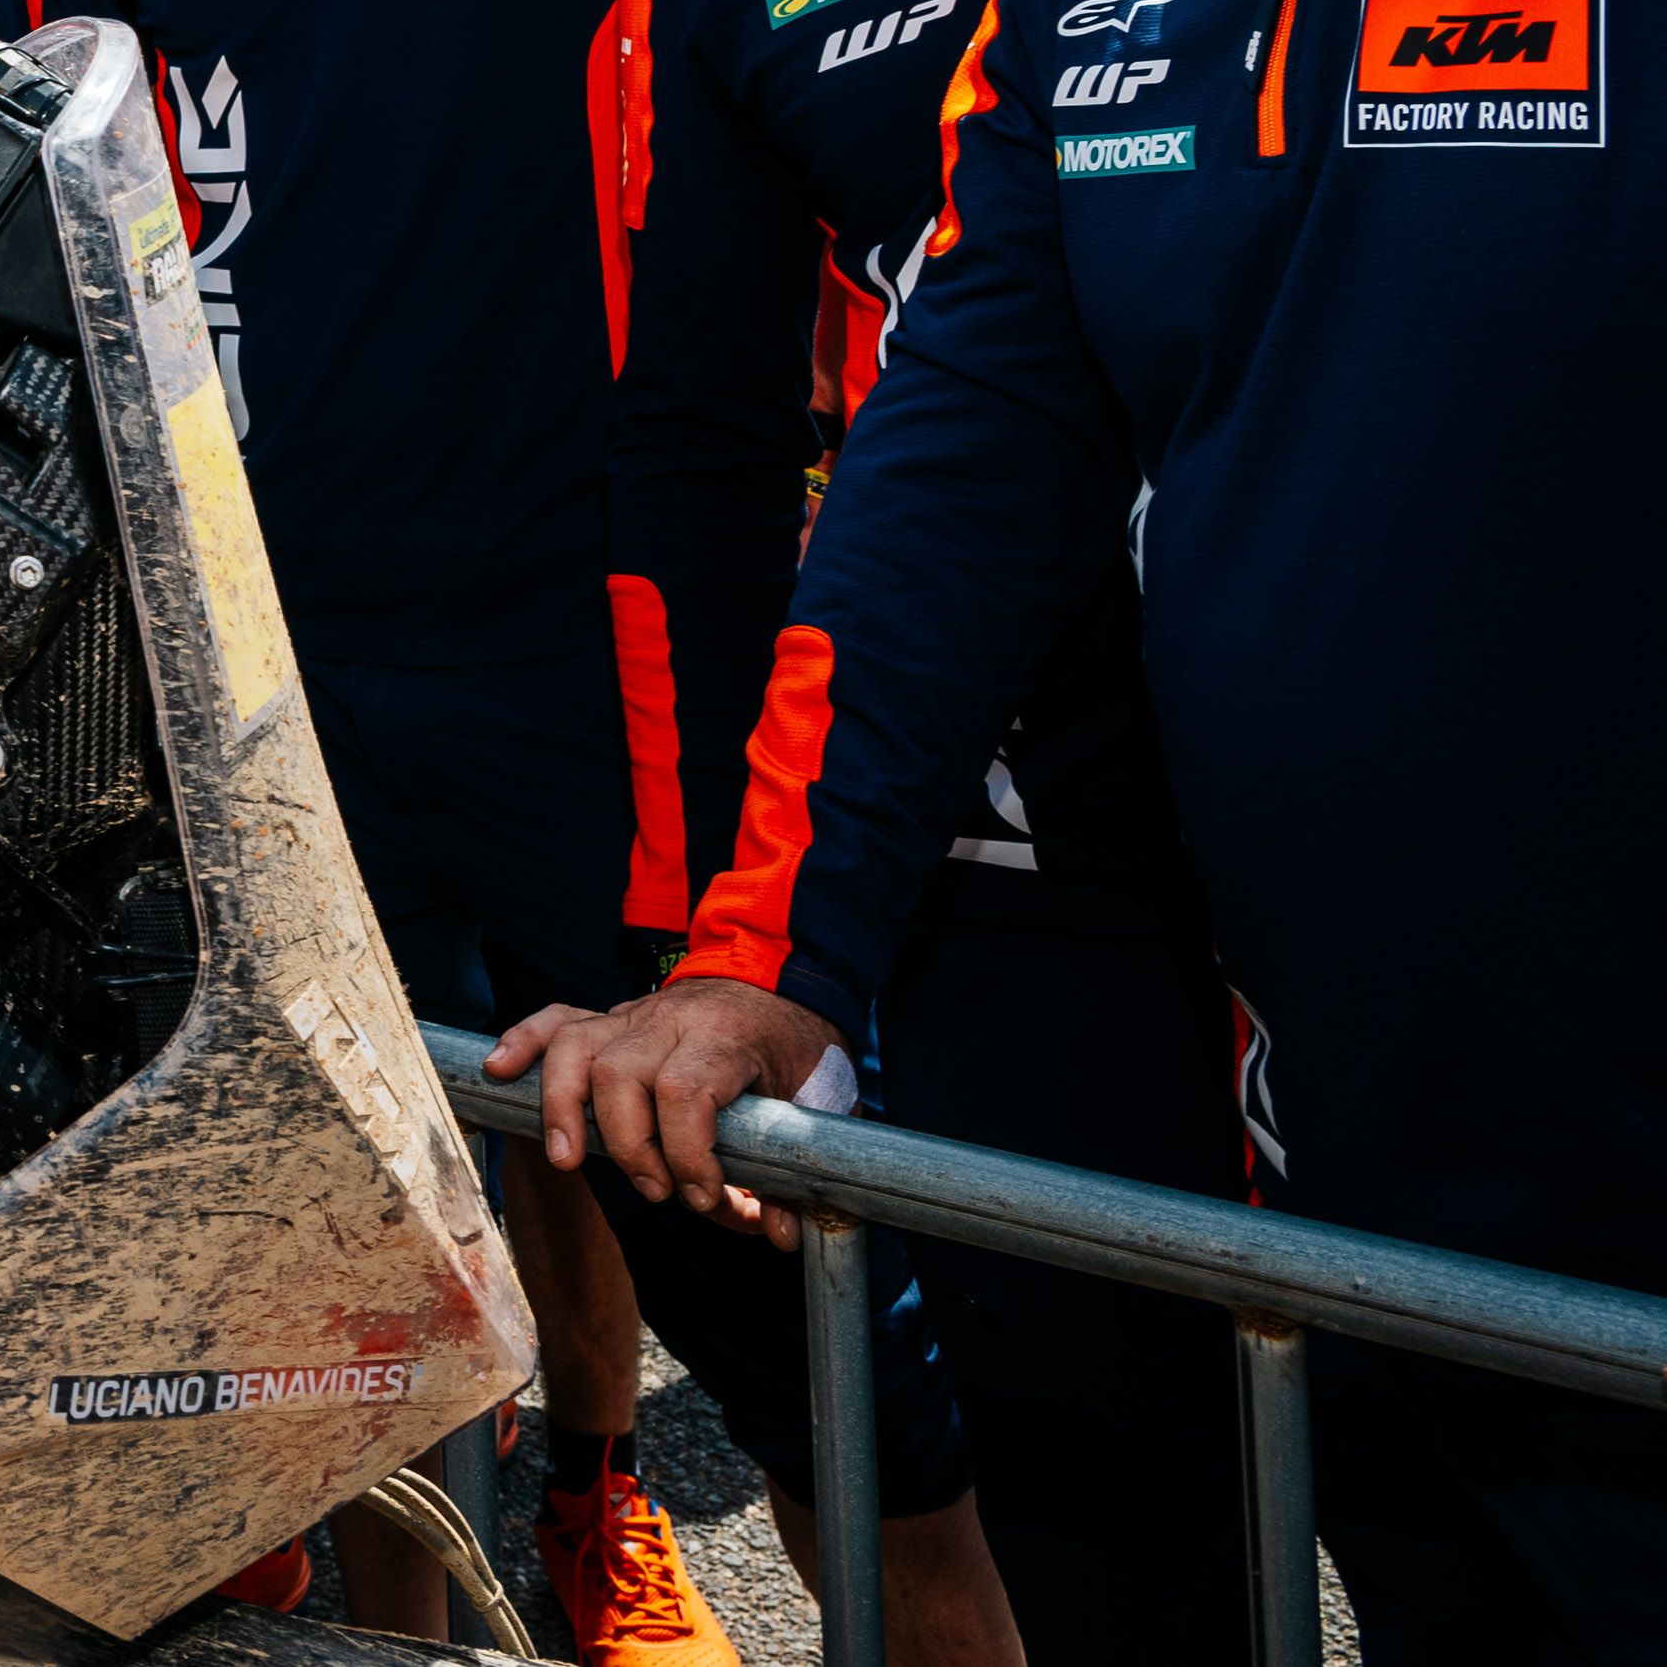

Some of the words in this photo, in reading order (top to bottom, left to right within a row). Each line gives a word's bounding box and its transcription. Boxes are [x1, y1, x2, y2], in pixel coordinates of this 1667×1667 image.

[1388, 10, 1556, 68] KTM
[1053, 59, 1170, 107] WP
[1358, 101, 1468, 131] FACTORY
[1478, 101, 1589, 131] RACING
[1064, 132, 1188, 172] MOTOREX
[49, 1376, 205, 1422] LUCIANO
[216, 1364, 405, 1412] BENAVIDES
